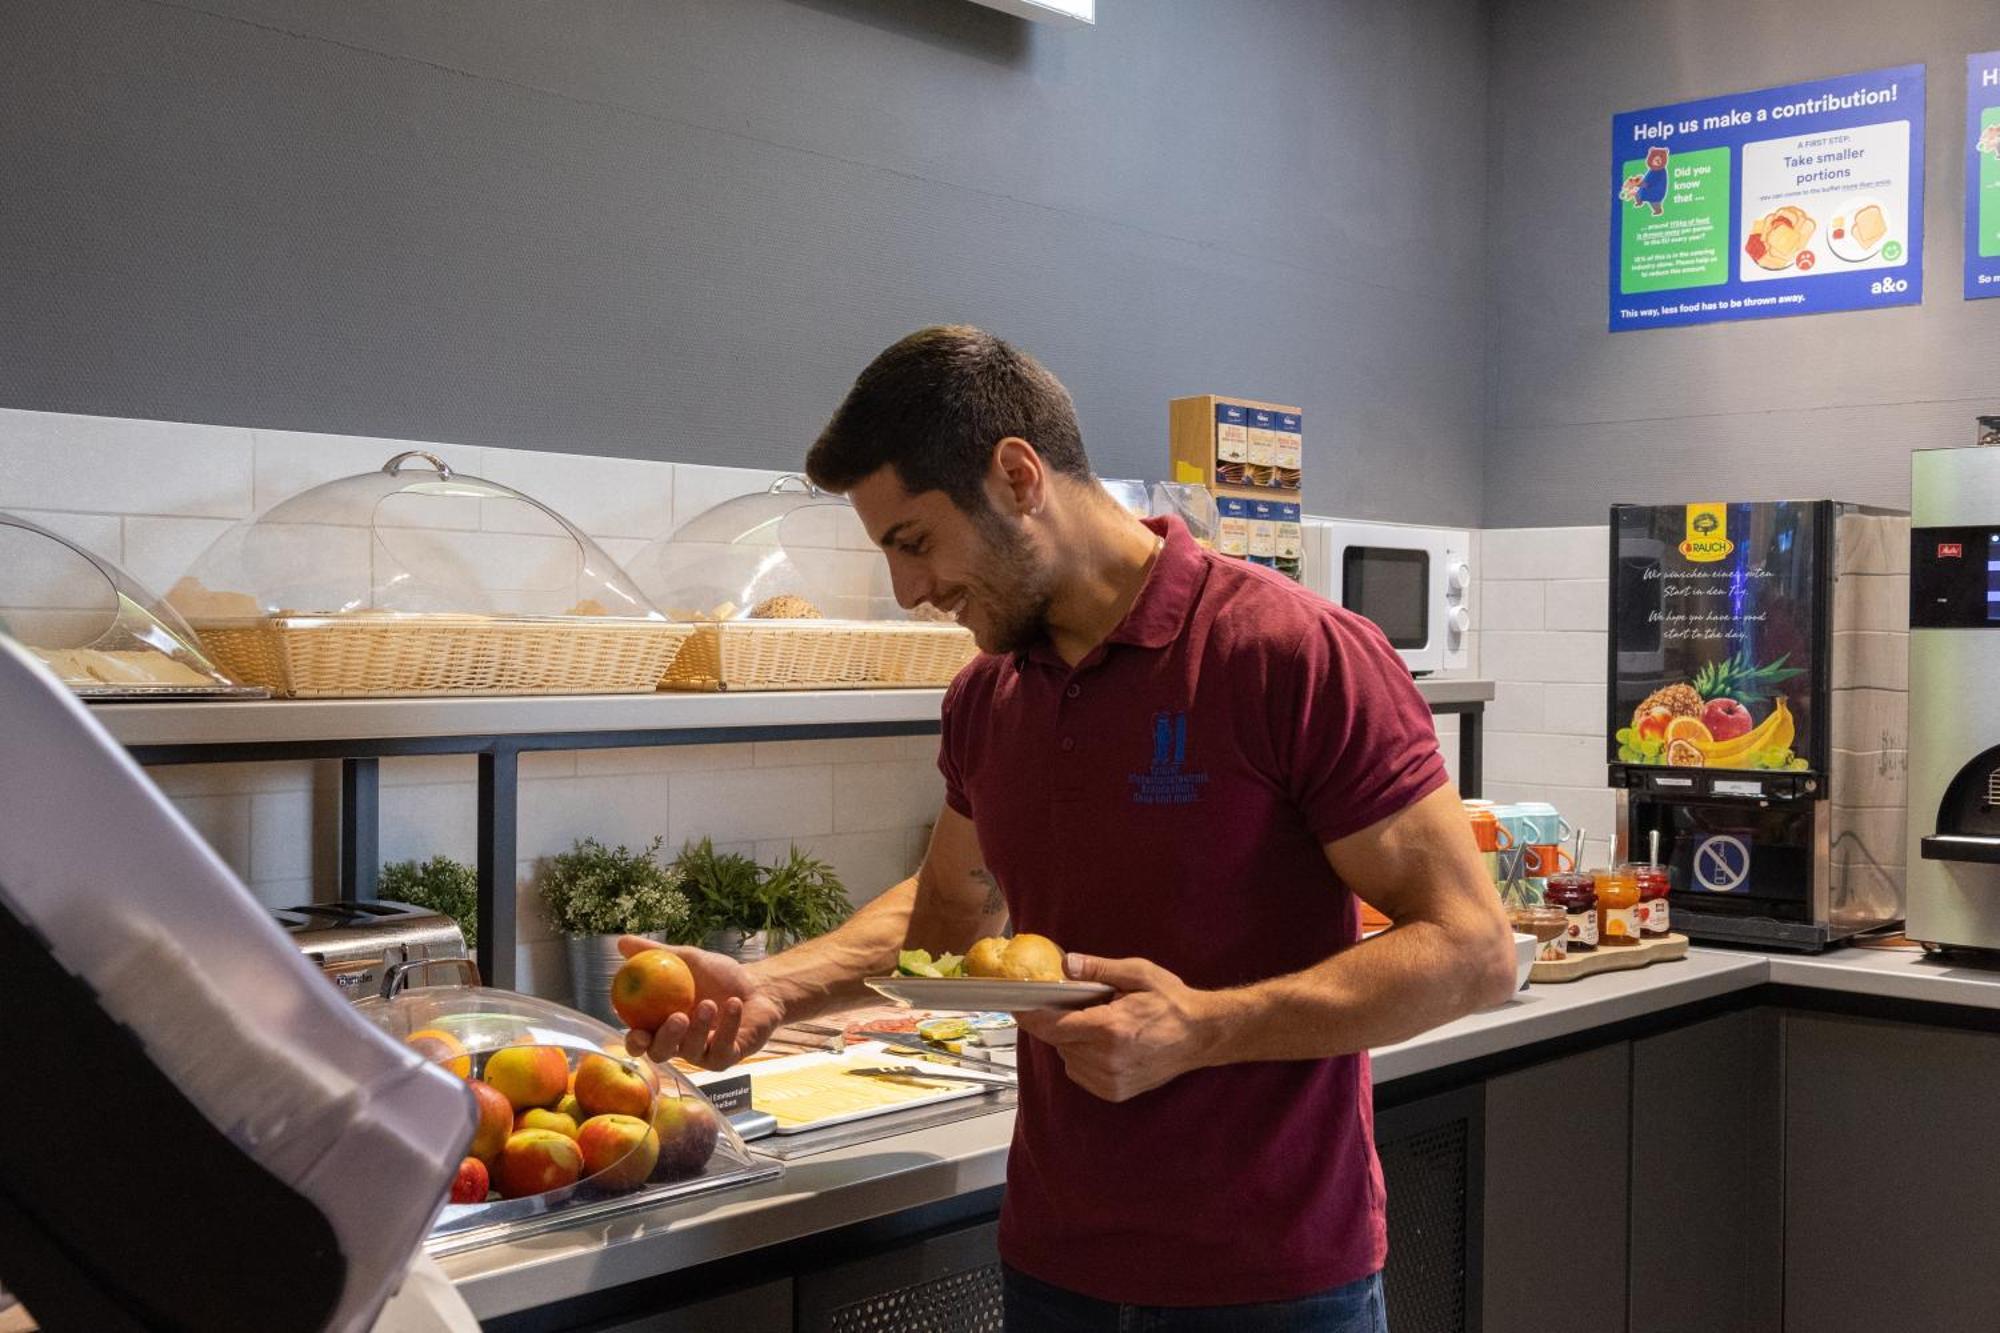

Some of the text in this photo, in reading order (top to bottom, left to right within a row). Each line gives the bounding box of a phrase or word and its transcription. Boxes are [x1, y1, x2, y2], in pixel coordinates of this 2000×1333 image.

[1634, 84, 1897, 141] Help us make a contribution!
[1805, 137, 1827, 148] FIRST
[1784, 148, 1864, 168] Take smaller
[1674, 165, 1711, 177] Did you
[1796, 168, 1851, 186] portions
[1674, 180, 1700, 190] know
[1674, 193, 1693, 203] that
[1871, 276, 1908, 294] a&o
[1620, 293, 1806, 318] This way, less food has to be thrown away.
[1693, 542, 1726, 553] RAUCH
[1663, 585, 1691, 598] Start
[1706, 586, 1727, 596] den
[1648, 610, 1664, 622] We
[1665, 610, 1687, 625] hope
[1688, 614, 1704, 625] you
[1705, 611, 1729, 621] have
[1743, 611, 1767, 625] good
[1663, 628, 1690, 639] start
[1691, 628, 1702, 639] to
[1703, 628, 1722, 639] the
